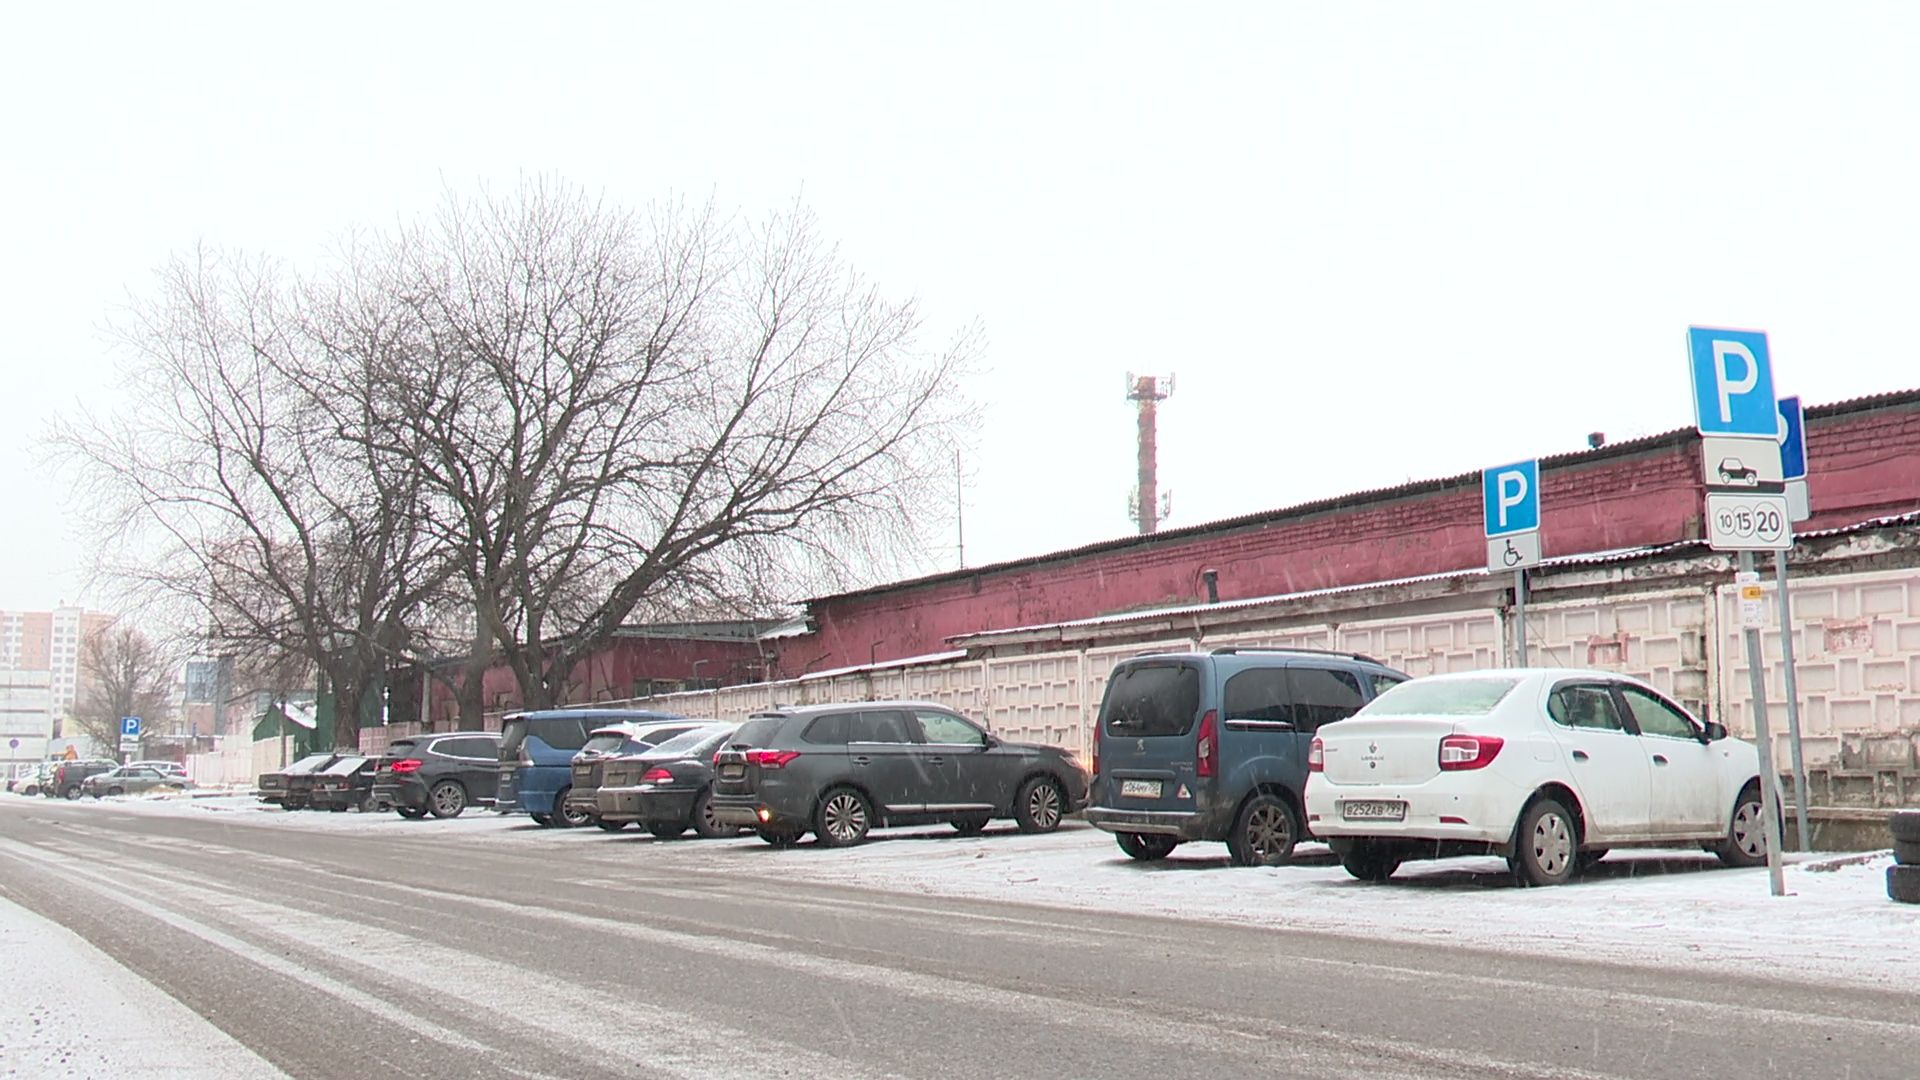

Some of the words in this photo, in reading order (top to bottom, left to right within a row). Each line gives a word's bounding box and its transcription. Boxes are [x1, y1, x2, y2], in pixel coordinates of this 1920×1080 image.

[1711, 339, 1759, 423] P
[1498, 470, 1528, 527] P
[1720, 514, 1733, 528] 10
[1736, 512, 1752, 531] 15
[1756, 511, 1780, 532] 20
[126, 719, 138, 734] P
